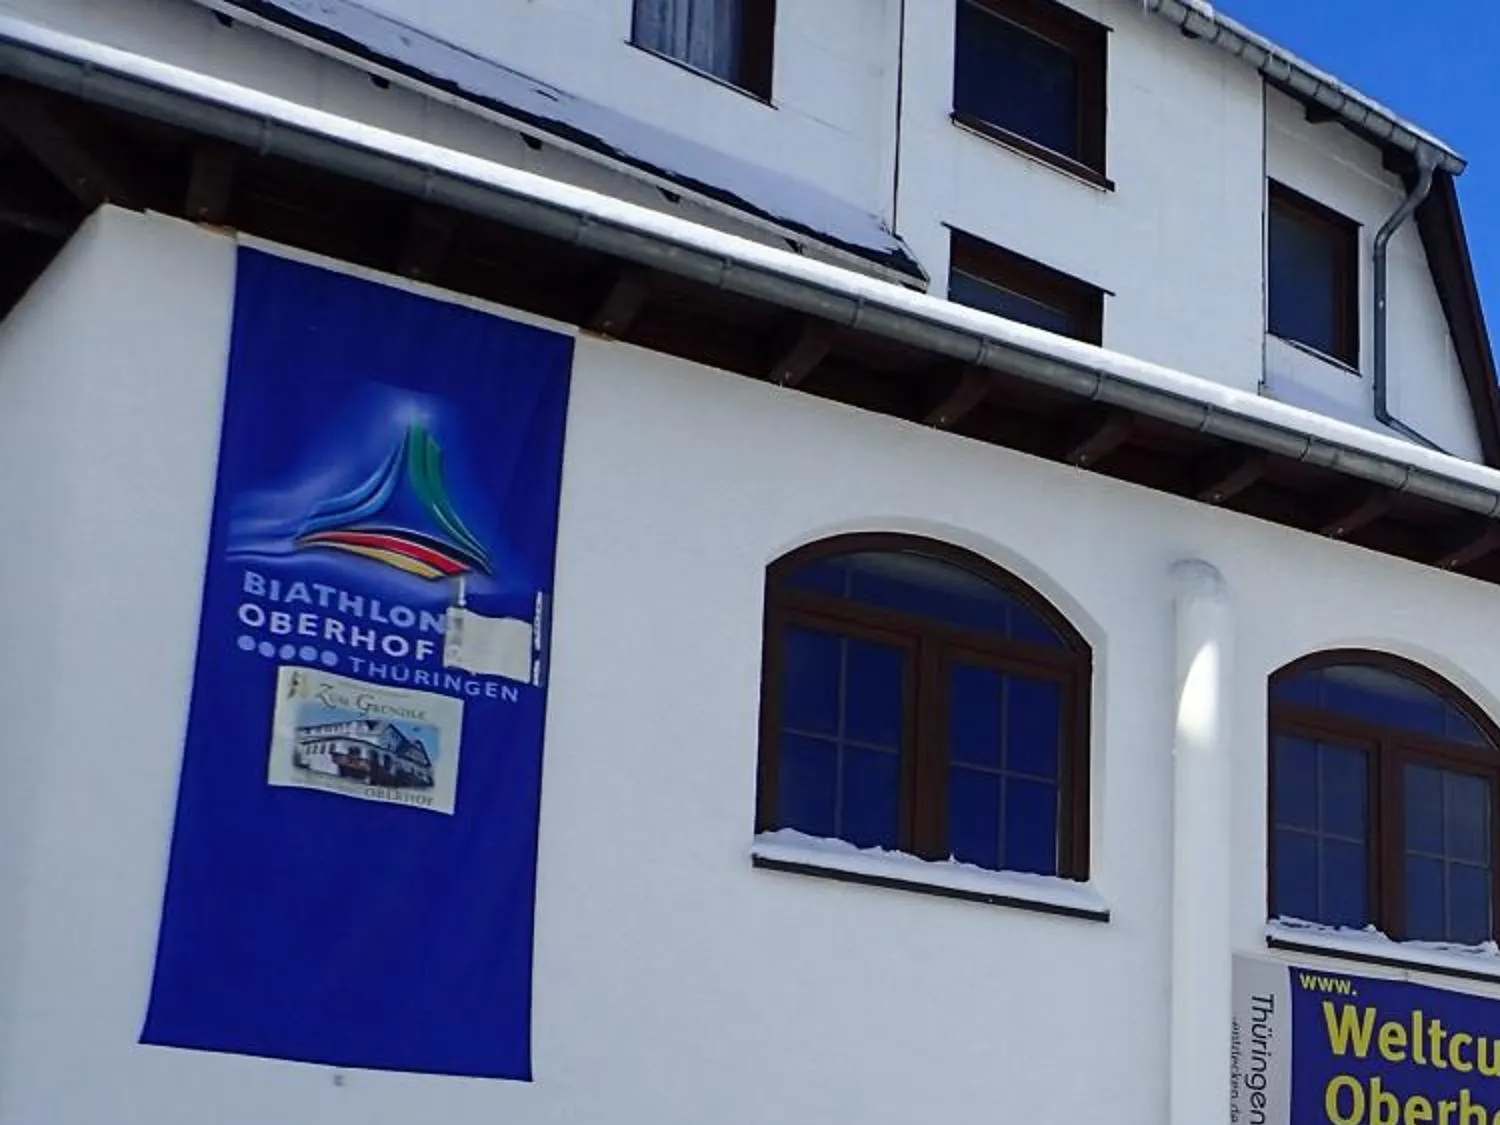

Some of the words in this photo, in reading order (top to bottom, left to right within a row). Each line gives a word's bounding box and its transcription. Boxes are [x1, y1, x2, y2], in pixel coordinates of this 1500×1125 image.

[238, 603, 435, 660] OBERHOF
[243, 571, 447, 635] BIATHLON
[349, 656, 520, 703] THÜRINGEN
[1300, 974, 1358, 996] www.
[1244, 993, 1275, 1125] Thüringen
